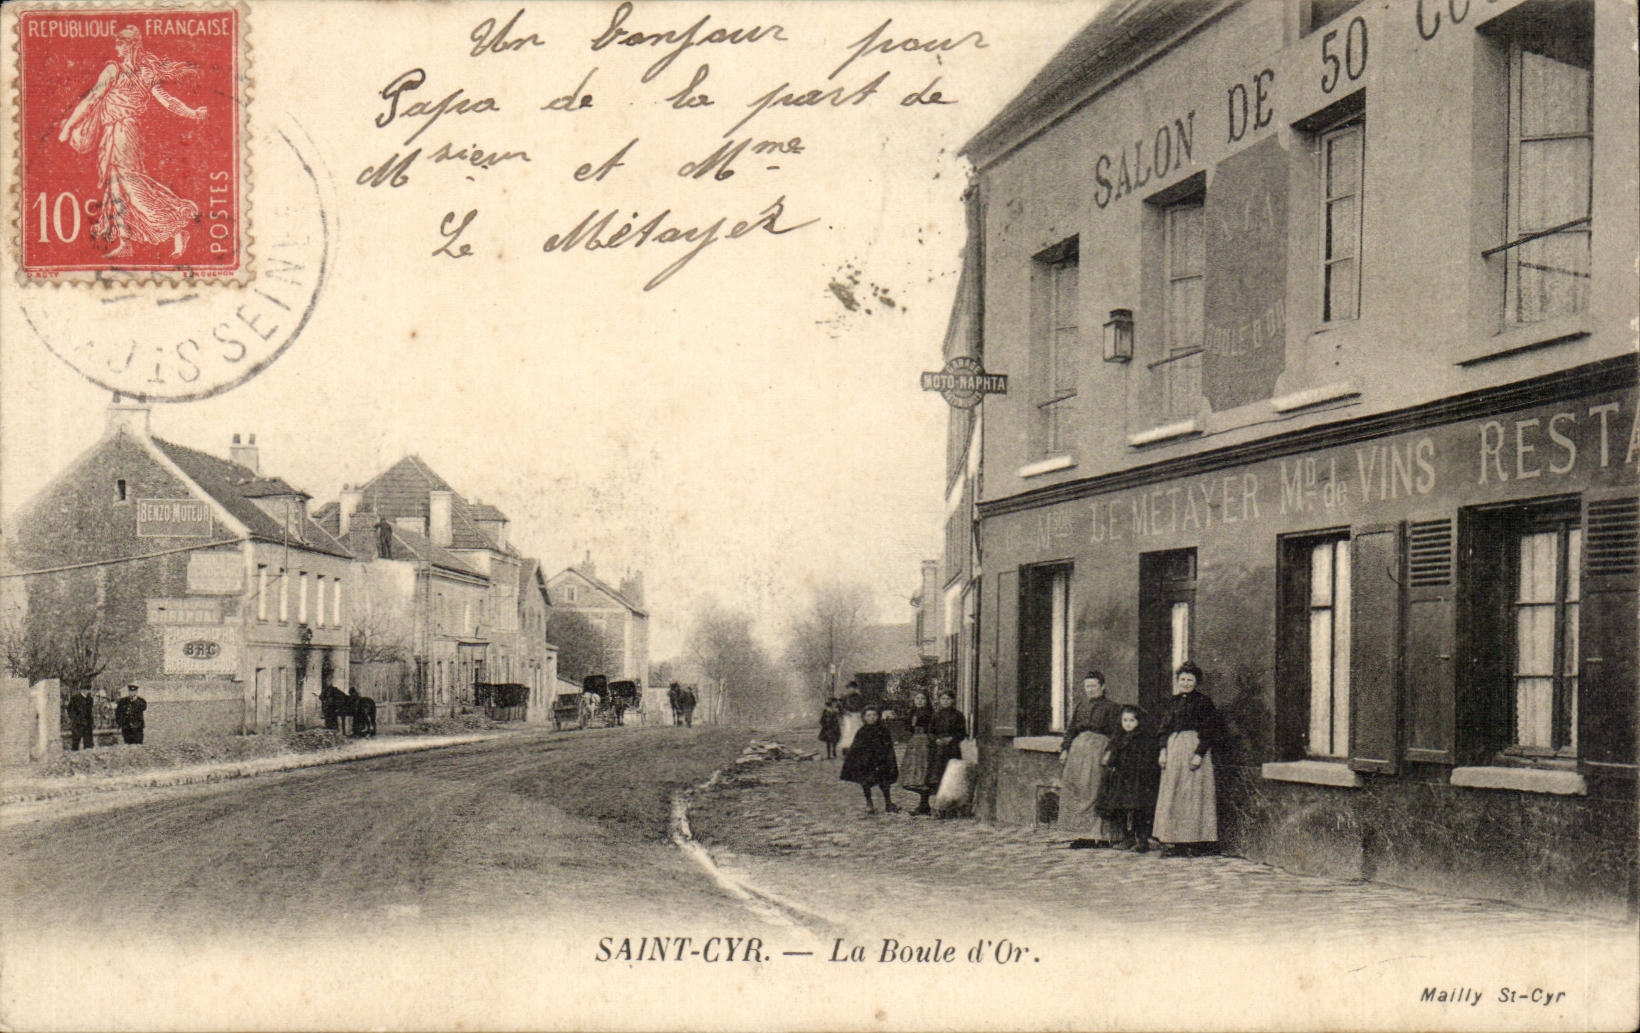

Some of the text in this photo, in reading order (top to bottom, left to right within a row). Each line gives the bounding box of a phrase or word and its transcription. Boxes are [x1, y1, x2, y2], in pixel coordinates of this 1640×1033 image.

[28, 17, 230, 38] REPUBLIQUE FRANÇAISE
[590, 1, 788, 84] bonjour
[835, 18, 990, 80] pour
[374, 63, 958, 143] Papa de la part de
[1094, 110, 1195, 210] SALON
[1227, 68, 1275, 145] DE
[1321, 16, 1368, 94] 50
[573, 138, 640, 182] et
[209, 171, 229, 254] POSTES
[431, 208, 478, 258] Le
[1356, 437, 1436, 502] VINS
